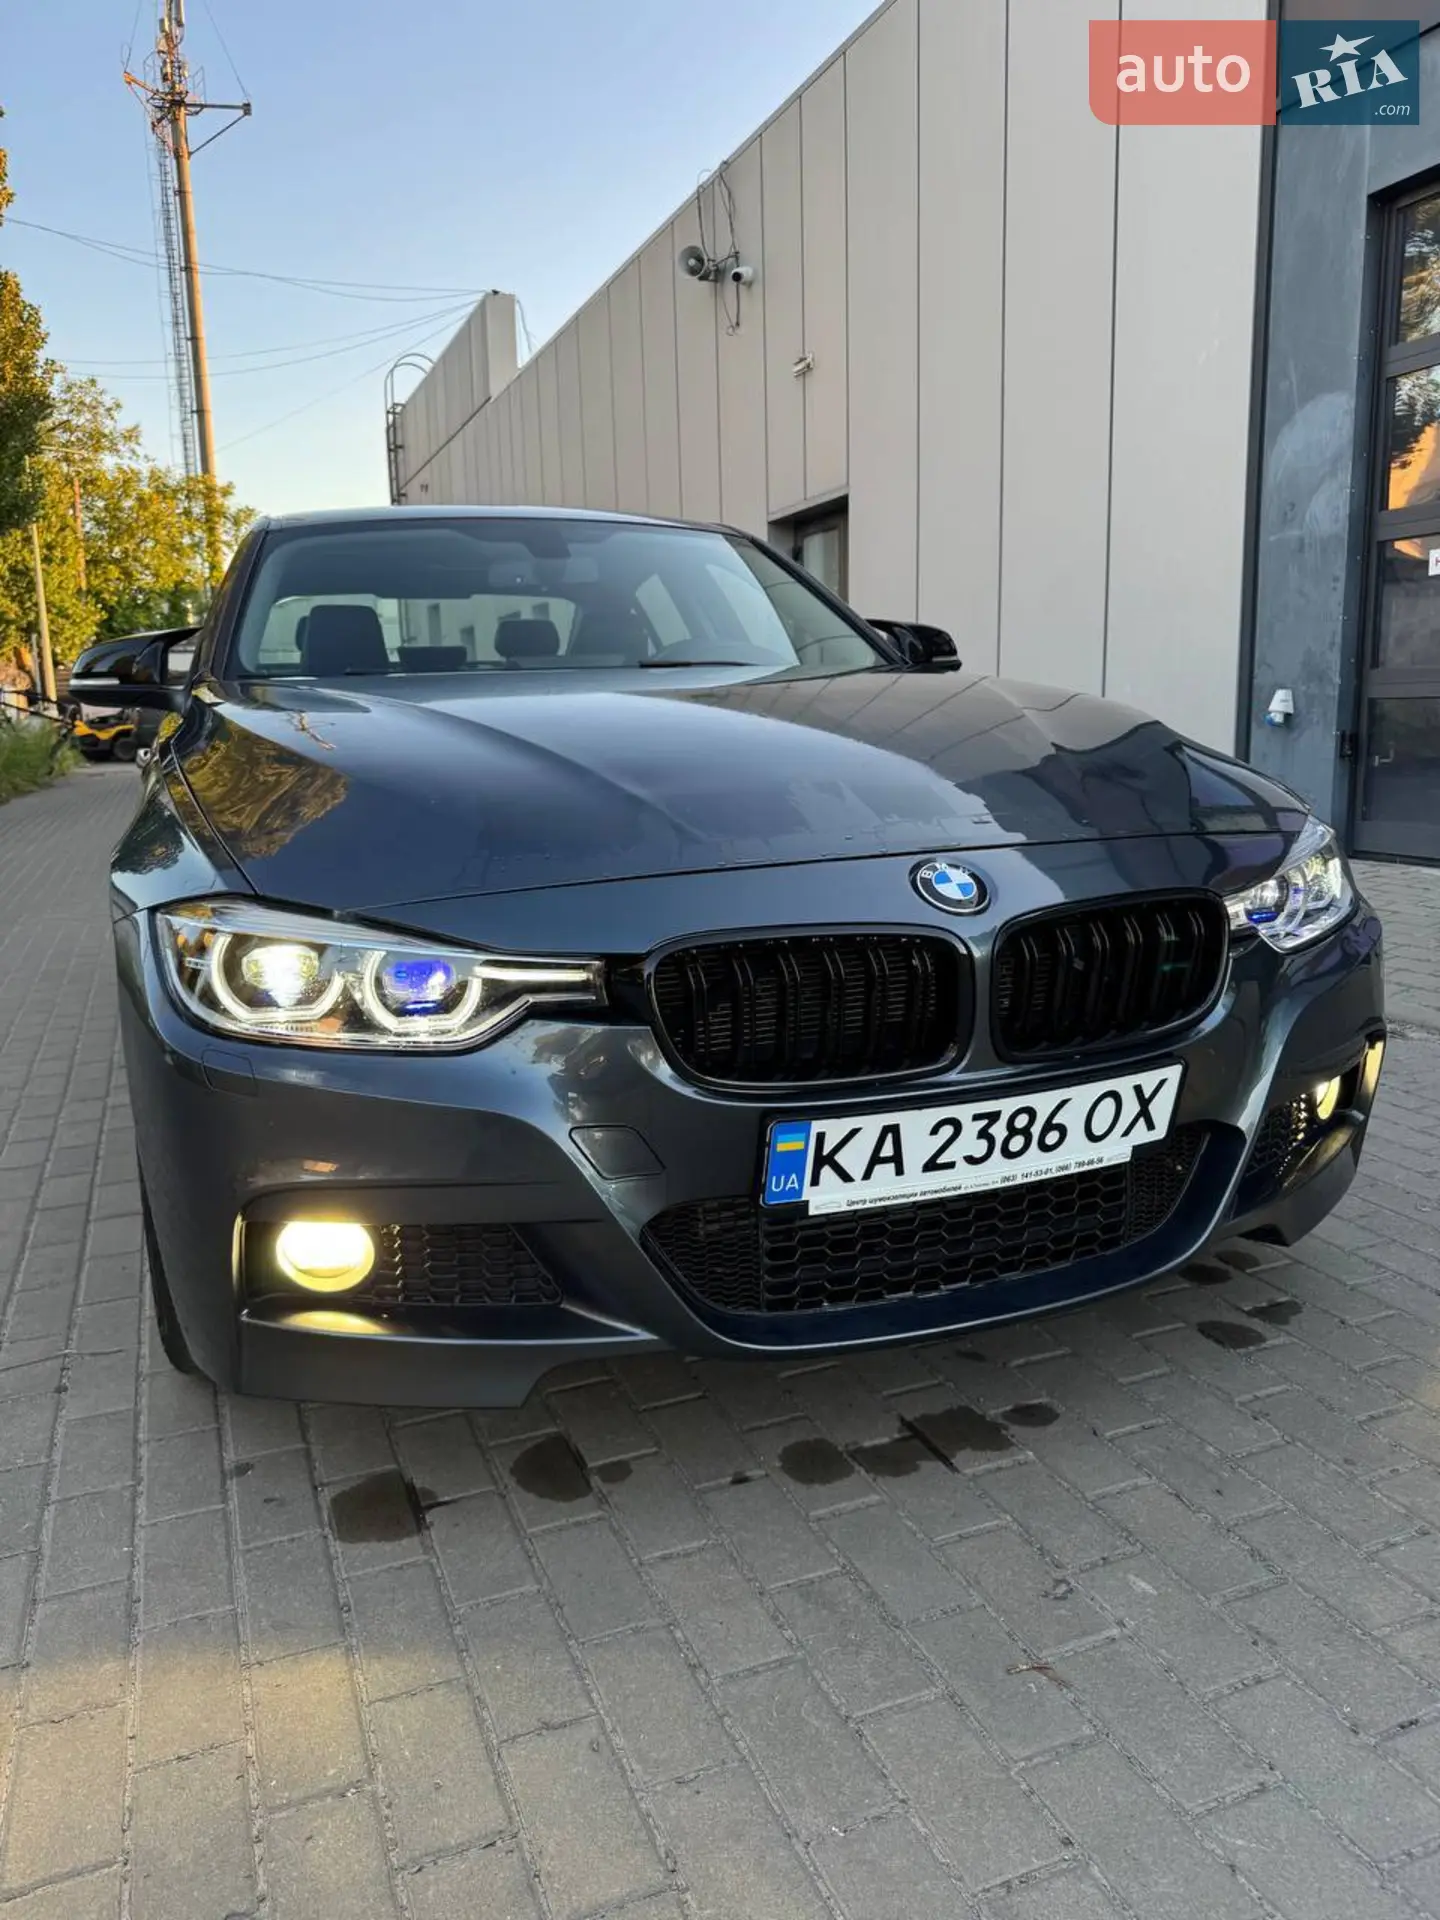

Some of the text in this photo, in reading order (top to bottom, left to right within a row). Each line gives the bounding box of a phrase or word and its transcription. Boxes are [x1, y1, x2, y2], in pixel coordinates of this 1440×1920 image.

[809, 1077, 1169, 1188] KA 2386 OX
[771, 1173, 799, 1193] UA
